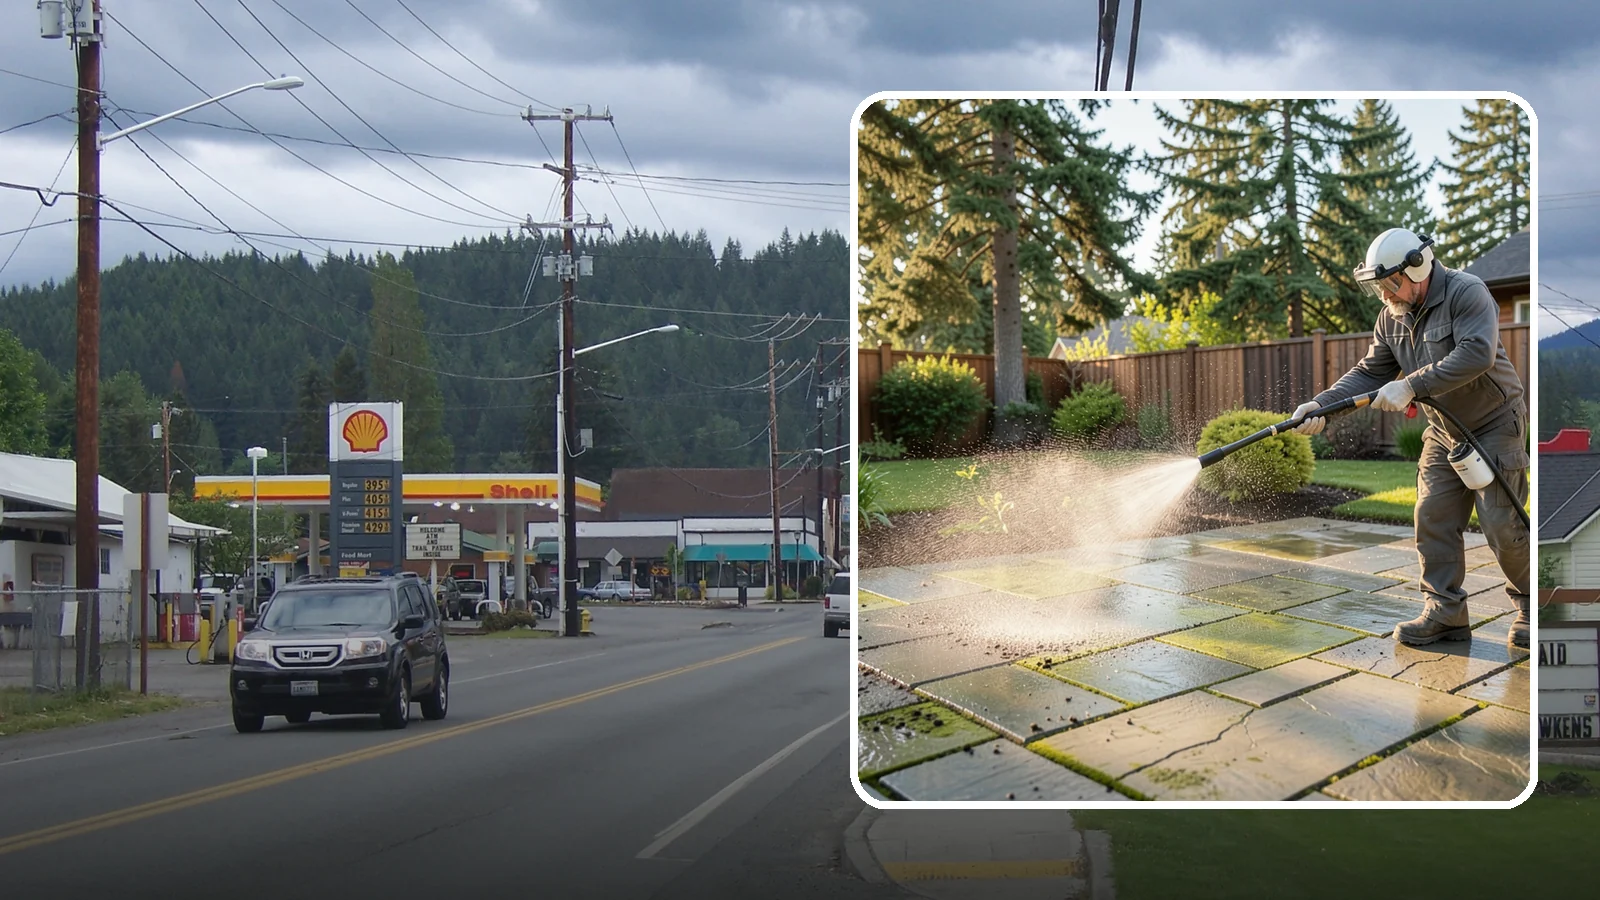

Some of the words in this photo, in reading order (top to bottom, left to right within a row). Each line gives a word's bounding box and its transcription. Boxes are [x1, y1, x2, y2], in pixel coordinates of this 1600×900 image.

[366, 480, 383, 490] 395
[490, 484, 547, 499] Shell
[366, 494, 383, 504] 405
[366, 508, 383, 518] 415
[366, 522, 383, 532] 429
[1538, 643, 1566, 665] AID
